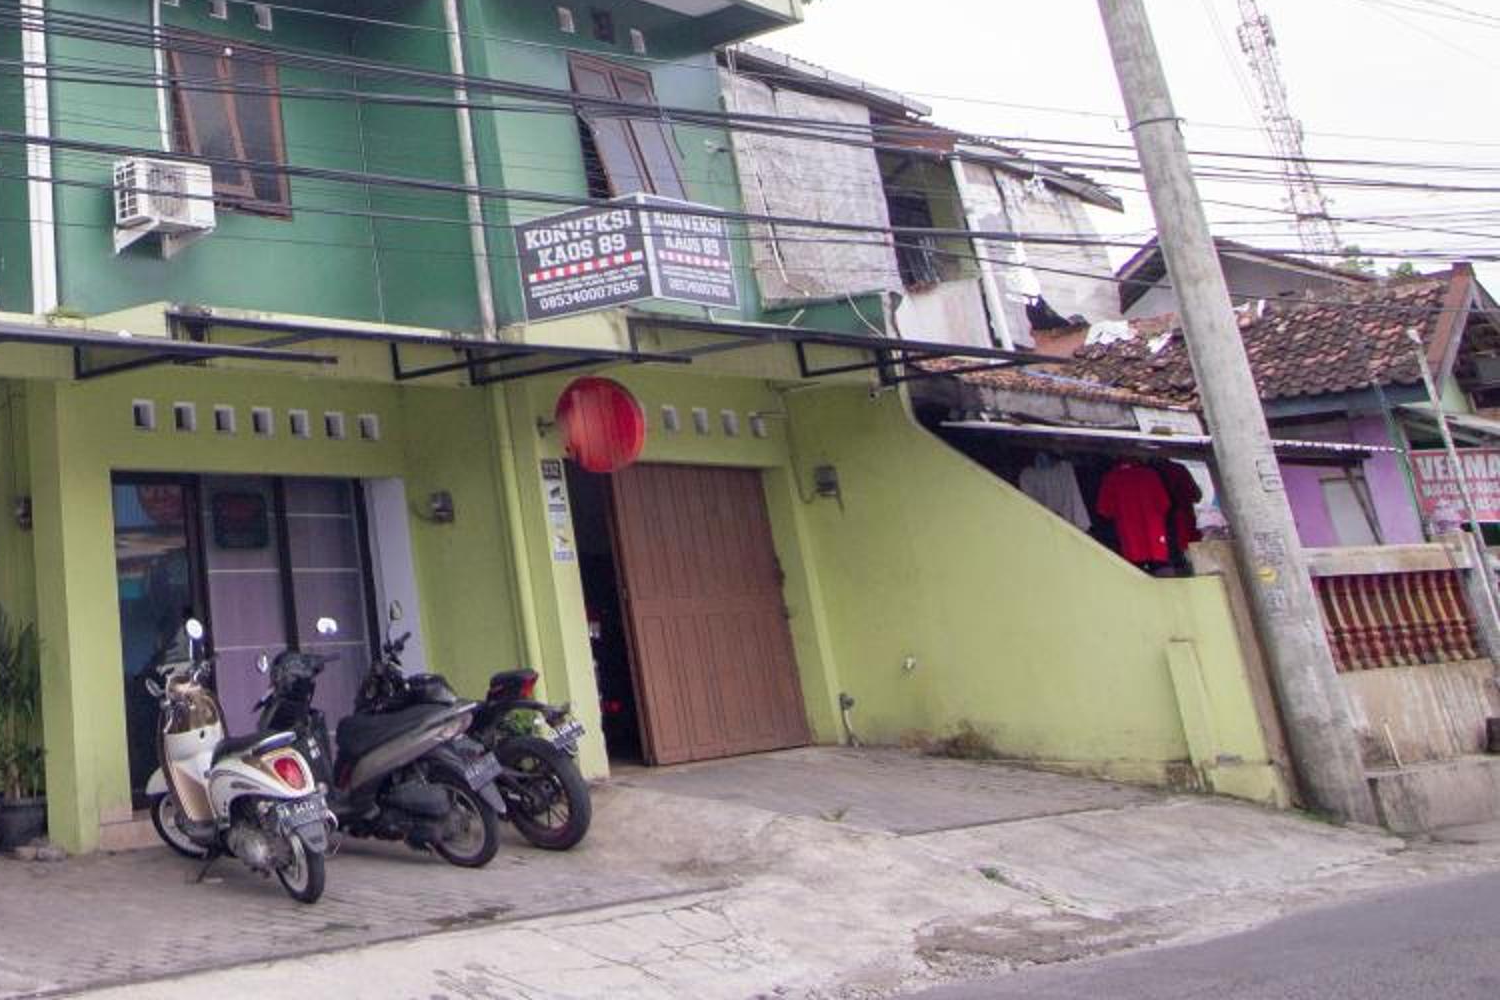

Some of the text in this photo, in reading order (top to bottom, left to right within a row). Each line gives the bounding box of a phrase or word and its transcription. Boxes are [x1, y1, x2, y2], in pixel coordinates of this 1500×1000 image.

[524, 209, 632, 249] KONVEKSI
[538, 233, 627, 267] KAOS 89
